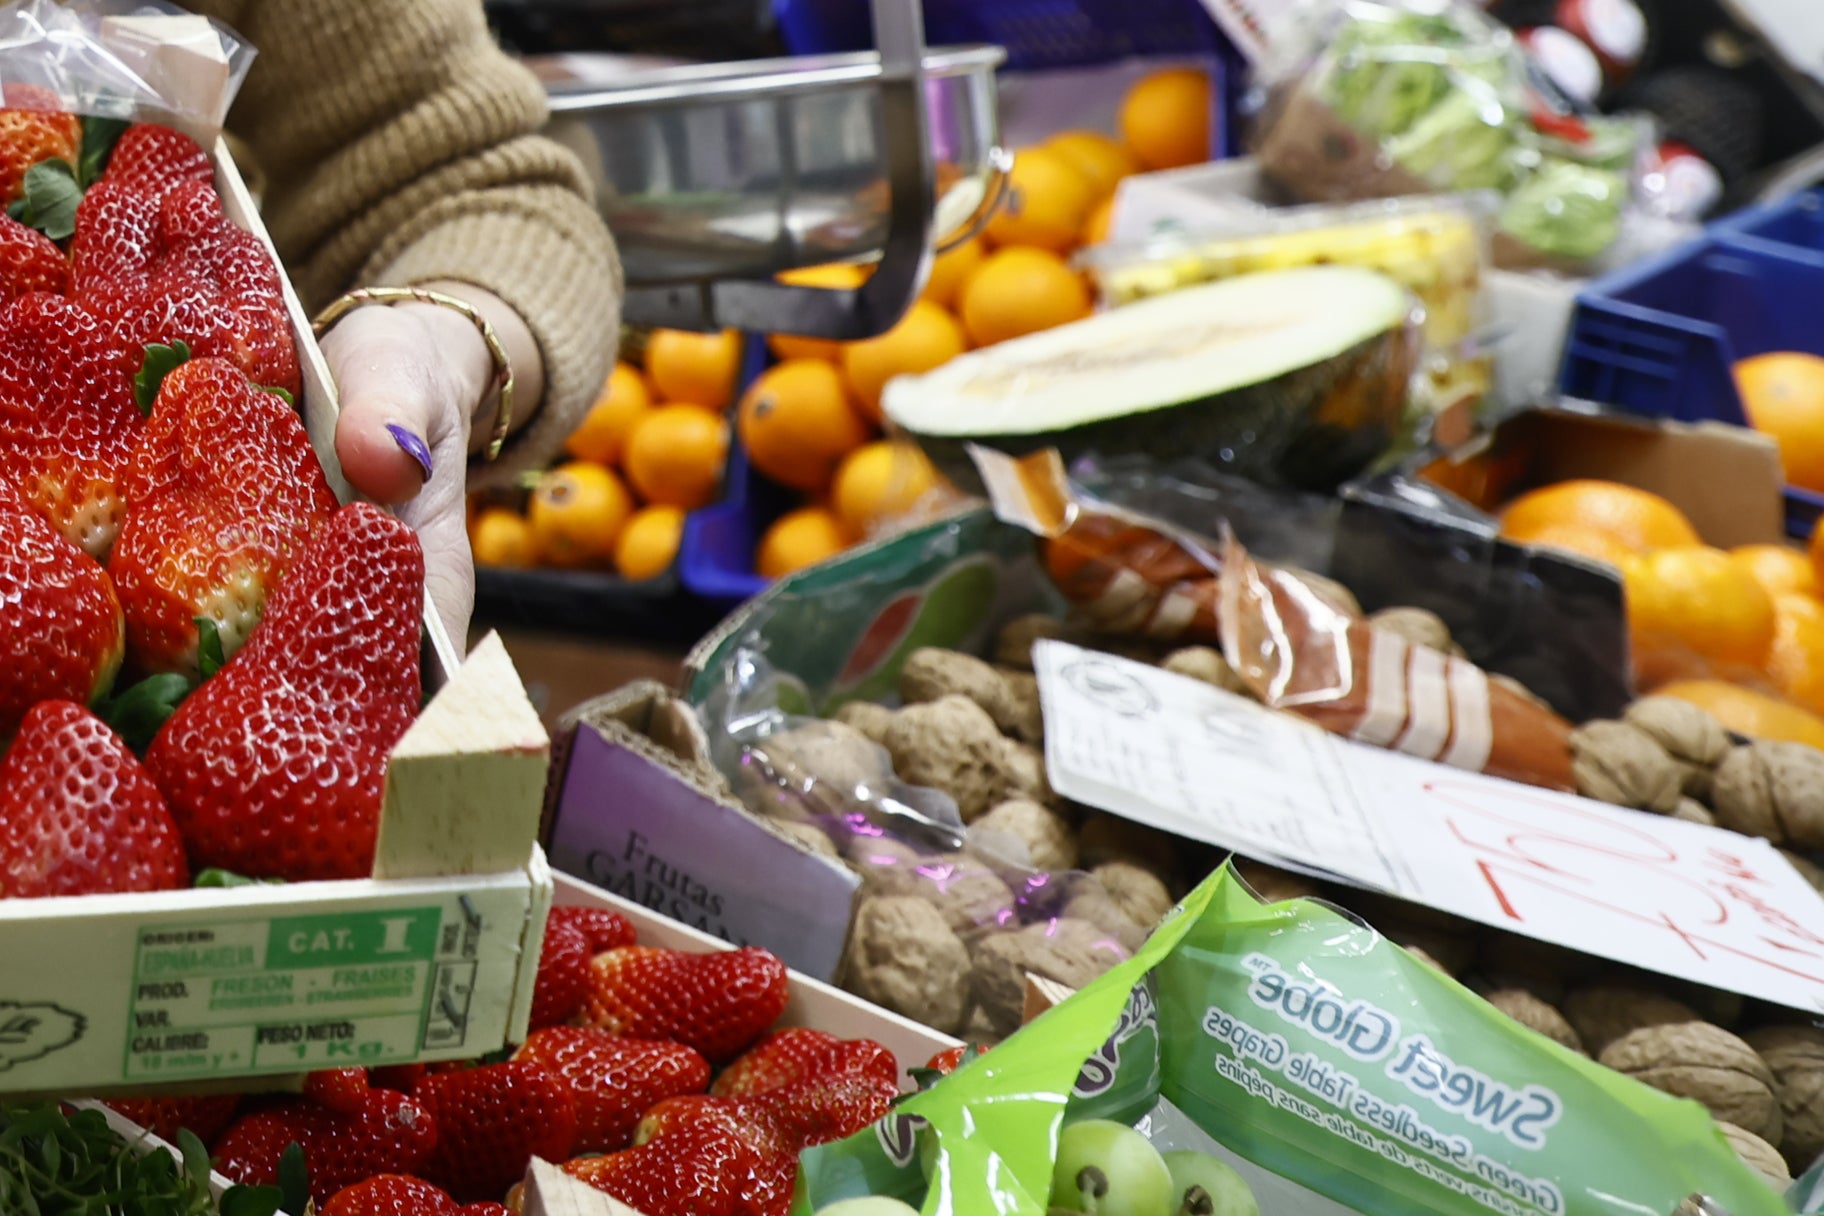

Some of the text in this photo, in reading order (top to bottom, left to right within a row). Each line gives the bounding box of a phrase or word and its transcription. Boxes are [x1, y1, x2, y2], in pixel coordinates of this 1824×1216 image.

[622, 829, 726, 917] Frutas
[287, 929, 354, 953] CAT.
[374, 916, 418, 954] I
[137, 981, 189, 1002] PROD.
[209, 973, 295, 997] FRESON
[331, 963, 417, 987] FRAISES
[135, 1008, 172, 1029] VAR.
[132, 1022, 357, 1054] CALIBRE: PESO NETO:
[326, 1039, 395, 1059] Kg.
